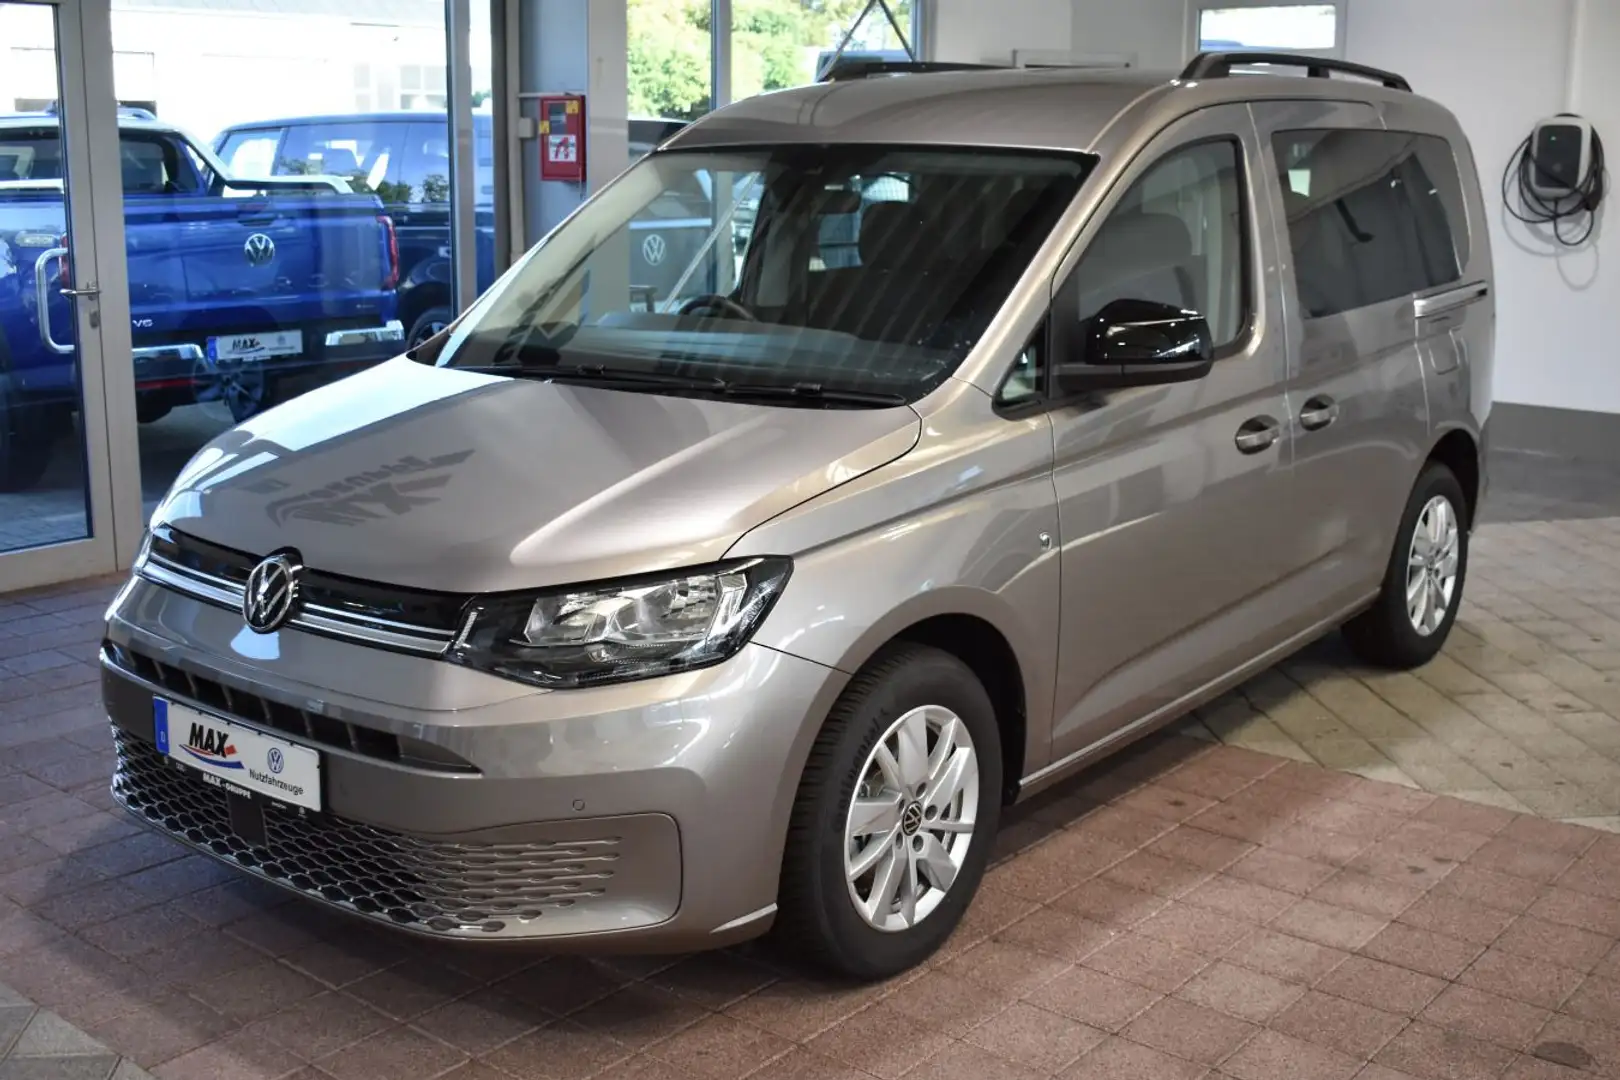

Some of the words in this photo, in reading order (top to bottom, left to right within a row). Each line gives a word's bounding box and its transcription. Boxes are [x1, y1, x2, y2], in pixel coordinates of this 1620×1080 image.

[233, 338, 256, 351] MAX
[189, 722, 229, 758] MAX
[249, 768, 304, 796] Nutzfahrzeuge
